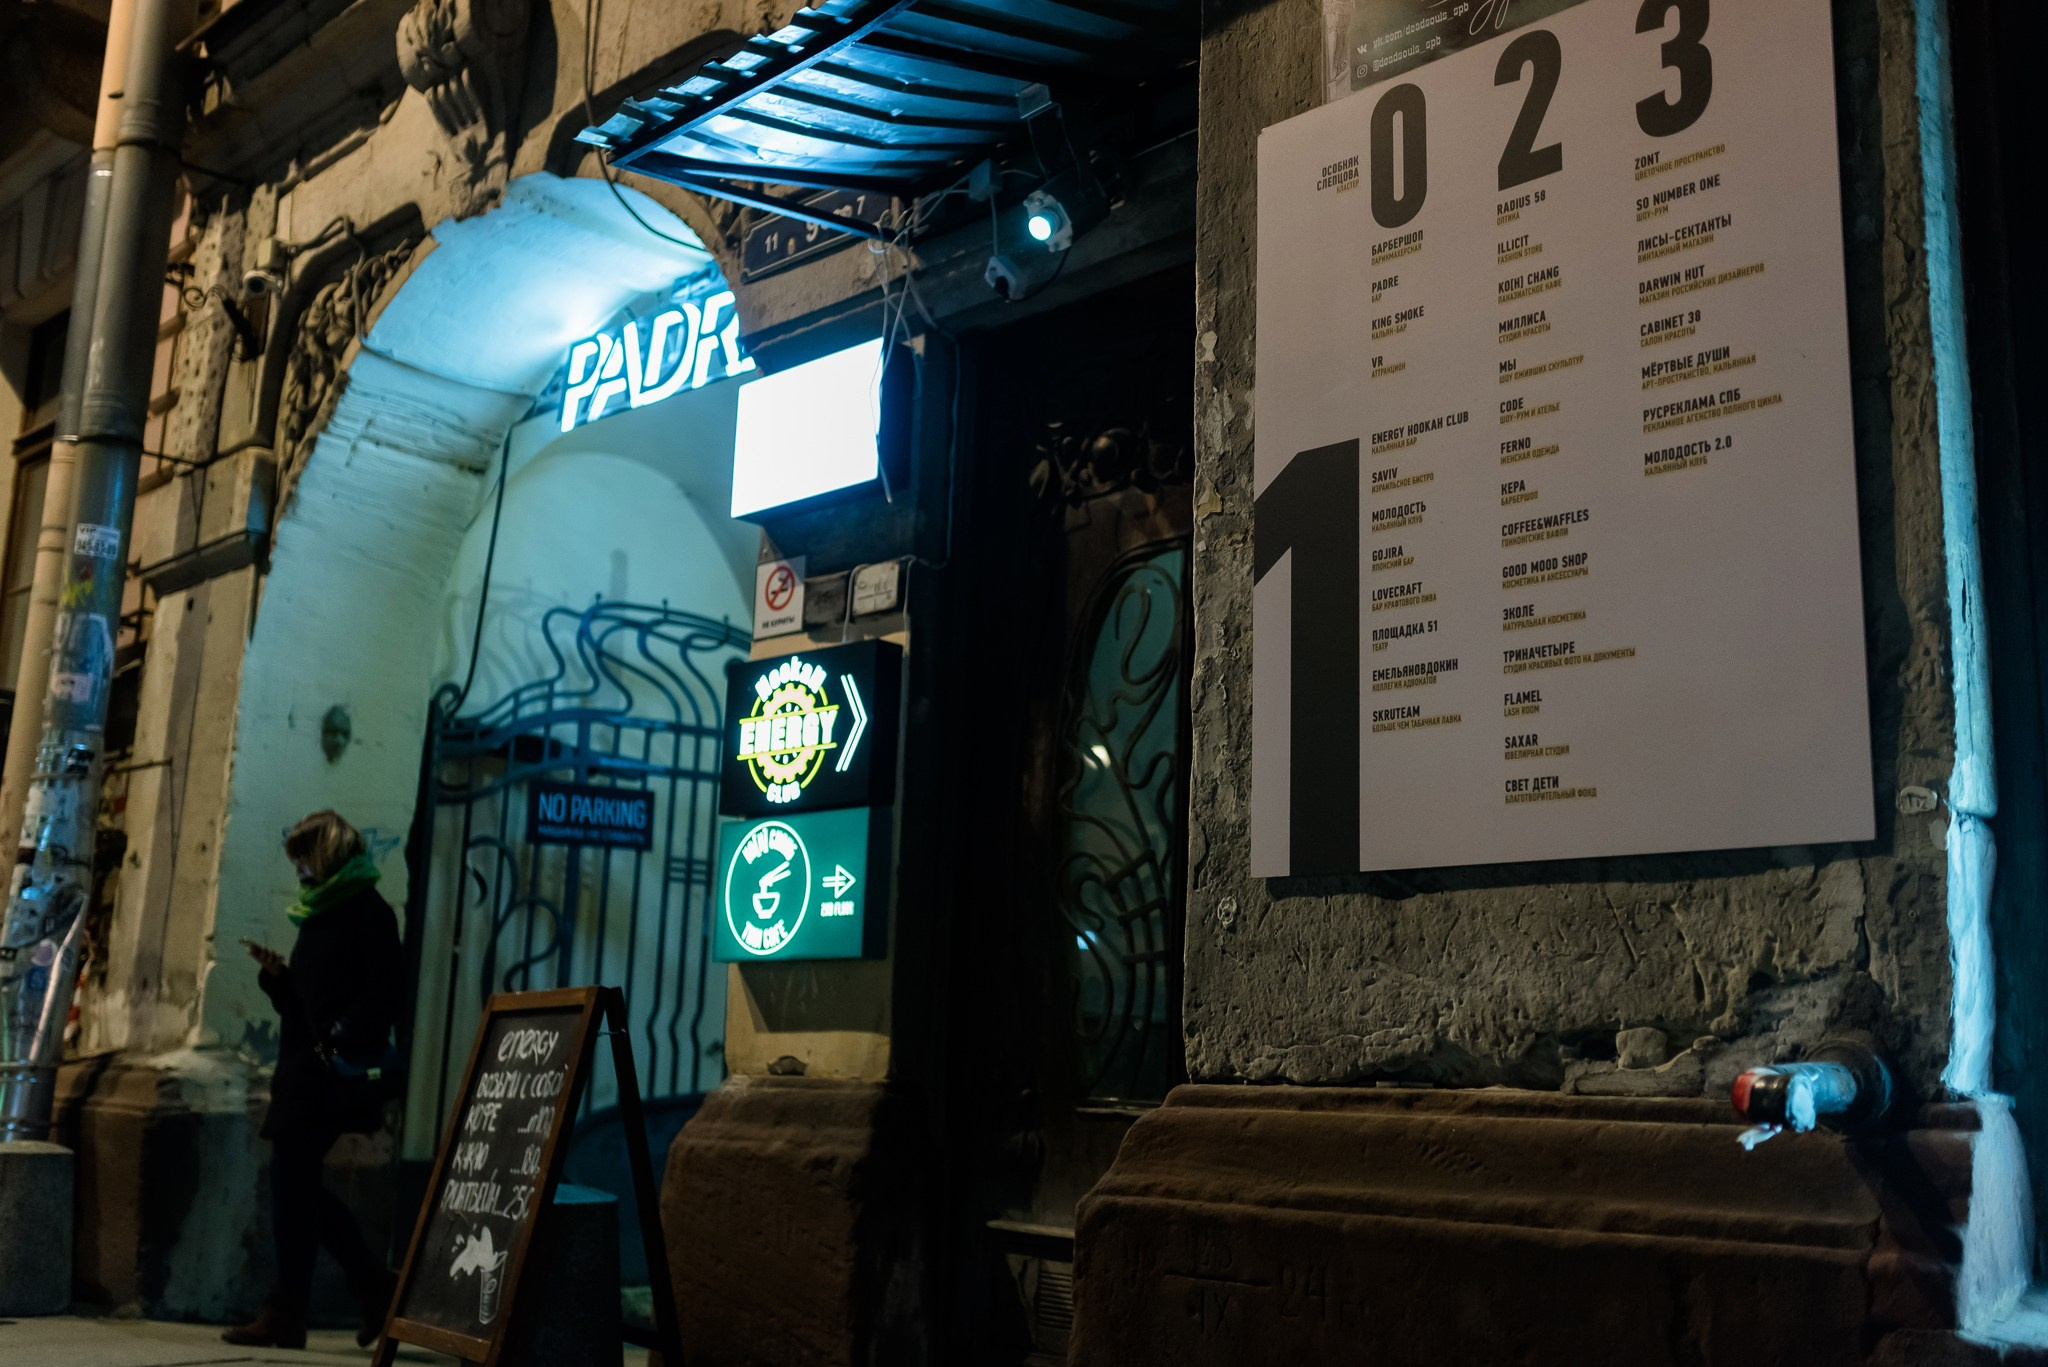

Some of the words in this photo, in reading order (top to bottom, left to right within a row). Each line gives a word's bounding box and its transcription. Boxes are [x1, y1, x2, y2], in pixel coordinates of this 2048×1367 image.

[1373, 3, 1469, 49] vk.com/deadsouls_spb
[1373, 36, 1441, 72] @deadsouls_spb
[1635, 0, 1712, 137] 3
[1494, 30, 1562, 191] 2
[1322, 155, 1359, 177] ОСОБНЯК
[1371, 83, 1427, 228] 0
[1635, 152, 1660, 170] ZONT
[1635, 162, 1672, 181] ЦВЕТОЧНОЕ
[1674, 144, 1725, 166] ПРОСТРАНСТВО
[1317, 170, 1359, 191] СЛЕПЦОВА
[1337, 180, 1359, 193] КЛАСТЕР
[1497, 195, 1530, 215] RADIUS
[1535, 190, 1545, 202] 58
[1637, 197, 1649, 211] SO
[1653, 182, 1695, 206] NUMBER
[1700, 174, 1720, 191] ONE
[1497, 213, 1520, 225] ОПТИКА
[1636, 205, 1669, 222] ШОУ-РУМ
[1372, 230, 1423, 256] БАРБЕРШОП
[1638, 214, 1731, 253] ЛИСЫ-СЕКТАНТЫ
[1372, 243, 1421, 265] ПАРИКМАХЕРСКАЯ
[1498, 235, 1529, 254] ILLICIT
[1498, 250, 1522, 264] FASHION
[1524, 244, 1542, 256] STORE
[1638, 244, 1680, 263] ВИНТАЖНЫЙ
[1683, 234, 1714, 250] МАГАЗИН
[1372, 276, 1398, 293] PADRE
[1499, 276, 1523, 293] KO[H]
[1528, 266, 1559, 285] CHANG
[1639, 272, 1680, 294] DARWIN
[1685, 265, 1705, 281] HUT
[1639, 290, 1669, 305] МАГАЗИН
[1672, 279, 1716, 296] РОССИЙСКИХ
[1718, 263, 1764, 284] ДИЗАЙНЕРОВ
[1372, 294, 1382, 303] БАР
[1498, 284, 1543, 304] ПАНАЗИАТСКОЕ
[1545, 279, 1561, 291] КАФЕ
[1372, 316, 1391, 330] KING
[1395, 306, 1424, 324] SMOKE
[1500, 311, 1546, 333] МИЛЛИСА
[1641, 314, 1684, 336] CABINET
[1688, 310, 1701, 323] 38
[1372, 324, 1407, 340] КАЛЬЯН-БАР
[1499, 330, 1521, 343] СТУДИЯ
[1523, 323, 1550, 336] КРАСОТЫ
[1641, 334, 1662, 347] САЛОН
[1665, 326, 1695, 341] КРАСОТЫ
[560, 290, 756, 433] PADR
[1372, 356, 1383, 368] VR
[1372, 363, 1405, 378] АТТРАКЦИОН
[1500, 359, 1516, 373] МЫ
[1500, 374, 1512, 383] ШОУ
[1515, 365, 1546, 380] ОЖИВШИХ
[1548, 355, 1584, 371] СКУЛЬПТУР
[1642, 356, 1693, 379] МЁРТВЫЕ
[1697, 346, 1730, 367] ДУШИ
[1642, 368, 1712, 390] АРТ-ПРОСТРАНСТВО,
[1713, 355, 1756, 372] КАЛЬЯННАЯ
[1500, 398, 1523, 413] CODE
[1500, 410, 1529, 424] ШОУ-РУМ
[1537, 403, 1560, 414] АТЕЛЬЕ
[1643, 395, 1715, 422] РУСРЕКЛАМА
[1720, 389, 1740, 404] СПБ
[1643, 416, 1684, 433] РЕКЛАМНОЕ
[1686, 407, 1721, 423] АГЕНСТВО
[1723, 400, 1755, 415] ПОЛНОГО
[1758, 394, 1782, 408] ЦИКЛА
[1372, 427, 1404, 444] ENERGY
[1408, 418, 1443, 436] HOOKAH
[1447, 411, 1468, 426] CLUB
[1372, 441, 1405, 455] КАЛЬЯННАЯ
[1407, 438, 1417, 446] БАР
[1501, 437, 1531, 454] FERNO
[1501, 451, 1530, 464] ЖЕНСКАЯ
[1533, 445, 1559, 458] ОДЕЖДА
[1645, 441, 1711, 465] МОЛОДОСТЬ
[1715, 436, 1732, 450] 2.0
[1372, 468, 1397, 483] SAVIV
[1645, 461, 1687, 476] КАЛЬЯННЫЙ
[1689, 456, 1707, 469] КЛУБ
[1372, 478, 1410, 493] ИЗРАИЛЬСКОЕ
[1412, 473, 1434, 484] БИСТРО
[1501, 491, 1538, 506] БАРБЕРШОП
[1372, 501, 1426, 522] МОЛОДОСТЬ
[1372, 518, 1406, 532] КАЛЬЯННЫЙ
[1408, 515, 1423, 525] КЛУБ
[1502, 509, 1589, 536] COFFEE&WAFFLES
[1502, 532, 1544, 547] ГОНКОНГСКИЕ
[1547, 528, 1568, 539] ВАФЛИ
[1372, 546, 1403, 561] GOJIRA
[1372, 560, 1401, 574] ЯПОНСКИЙ
[1403, 557, 1414, 567] БАР
[1503, 563, 1527, 578] GOOD
[1531, 558, 1558, 573] MOOD
[1562, 553, 1588, 568] SHOP
[1503, 576, 1539, 589] КОСМЕТИКА
[1547, 568, 1588, 581] АКСЕССУАРЫ
[1373, 582, 1422, 601] LOVECRAFT
[1372, 603, 1382, 611] БАР
[1384, 597, 1420, 610] КРАФТОВОГО
[1421, 594, 1436, 602] ПИВА
[1503, 605, 1534, 620] ЭКОЛЕ
[1373, 623, 1424, 641] ПЛОЩАДКА
[1428, 620, 1438, 632] 51
[1503, 618, 1546, 631] НАТУРАЛЬНАЯ
[1548, 611, 1586, 624] КОСМЕТИКА
[1253, 437, 1360, 877] 1
[1373, 642, 1388, 651] ТЕАТР
[1504, 641, 1575, 663] ТРИНАЧЕТЫРЕ
[1373, 659, 1458, 681] ЕМЕЛЬЯНОВДОКИН
[1504, 664, 1526, 674] СТУДИЯ
[1529, 658, 1562, 670] КРАСИВЫХ
[1564, 656, 1581, 665] ФОТО
[1583, 655, 1591, 663] НА
[1594, 648, 1635, 662] ДОКУМЕНТЫ
[1373, 681, 1401, 692] КОЛЛЕГИЯ
[1403, 676, 1437, 688] АДВОКАТОВ
[1505, 690, 1542, 705] FLAMEL
[1373, 705, 1420, 722] SKRUTEAM
[1504, 707, 1519, 717] LASH
[1522, 705, 1539, 714] ROOM
[739, 709, 838, 755] ENERGY
[1373, 722, 1396, 733] БОЛЬШЕ
[1397, 721, 1409, 730] ЧЕМ
[1411, 717, 1440, 728] ТАБАЧНАЯ
[1442, 715, 1461, 725] ЛАВКА
[1505, 734, 1538, 748] SAXAR
[1505, 749, 1543, 760] ЮВЕЛИРНАЯ
[1545, 745, 1569, 756] СТУДИЯ
[1506, 779, 1529, 792] СВЕТ
[1533, 776, 1559, 791] ДЕТИ
[1505, 789, 1575, 804] БЛАГОТВОРИТЕЛЬНЫЙ
[1578, 788, 1596, 798] ФОНД
[539, 792, 567, 822] NO
[570, 794, 647, 829] PARKING
